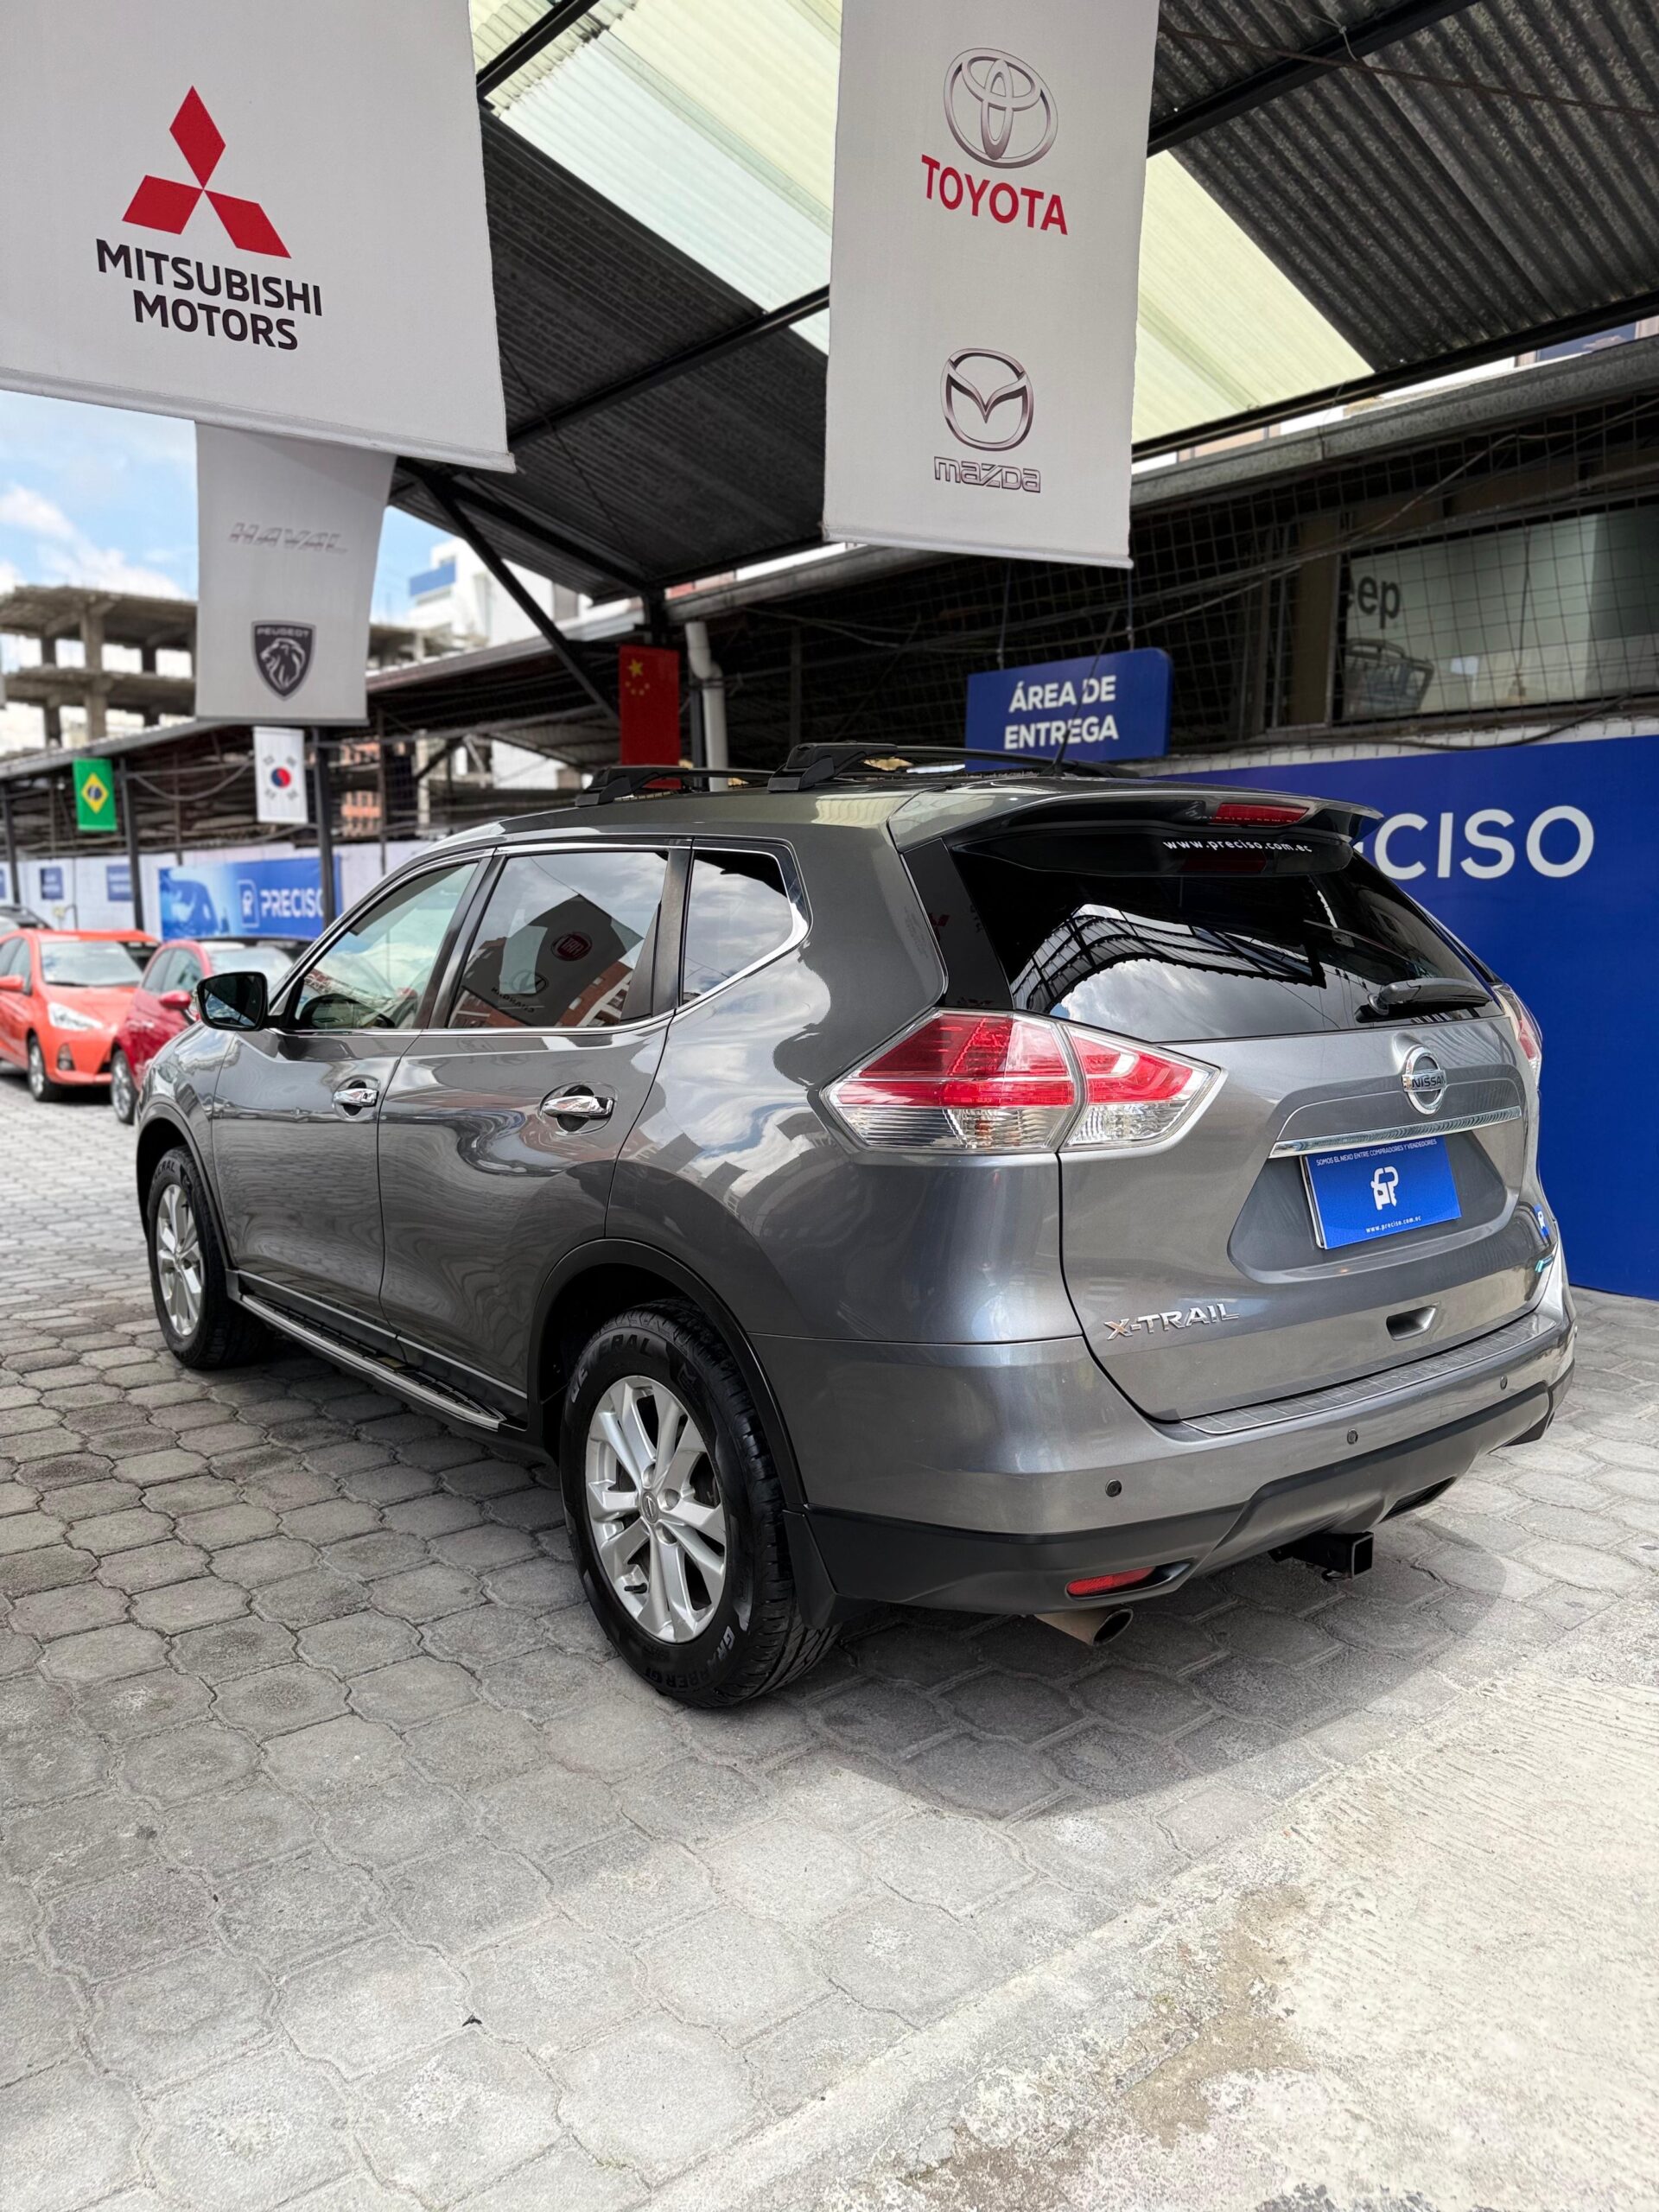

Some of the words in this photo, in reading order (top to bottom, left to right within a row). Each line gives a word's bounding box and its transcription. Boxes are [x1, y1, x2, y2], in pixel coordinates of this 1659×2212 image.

[920, 154, 1068, 235] TOYOTA
[96, 238, 323, 316] MITSUBISHI
[133, 289, 298, 350] MOTORS
[228, 522, 347, 554] HAVAL
[1347, 575, 1401, 630] ep
[257, 627, 309, 639] PEUGEOT
[1008, 680, 1077, 714] ÁREA
[1081, 675, 1117, 704] DE
[1004, 715, 1119, 750] ENTREGA
[1163, 839, 1312, 854] www.preciso.com.ec
[1353, 805, 1594, 880] CISO
[1412, 1075, 1446, 1089] NISSAN
[1316, 1157, 1334, 1166] SOMOS
[1340, 1153, 1354, 1162] NEXO
[1354, 1150, 1370, 1160] ENTRE
[1370, 1146, 1404, 1157] COMPRADORES
[1408, 1139, 1438, 1150] VENDEDORES
[1365, 1216, 1422, 1234] www.preciso.com.ec
[1103, 1303, 1240, 1341] X-TRAIL
[569, 1333, 652, 1404] GEERAL
